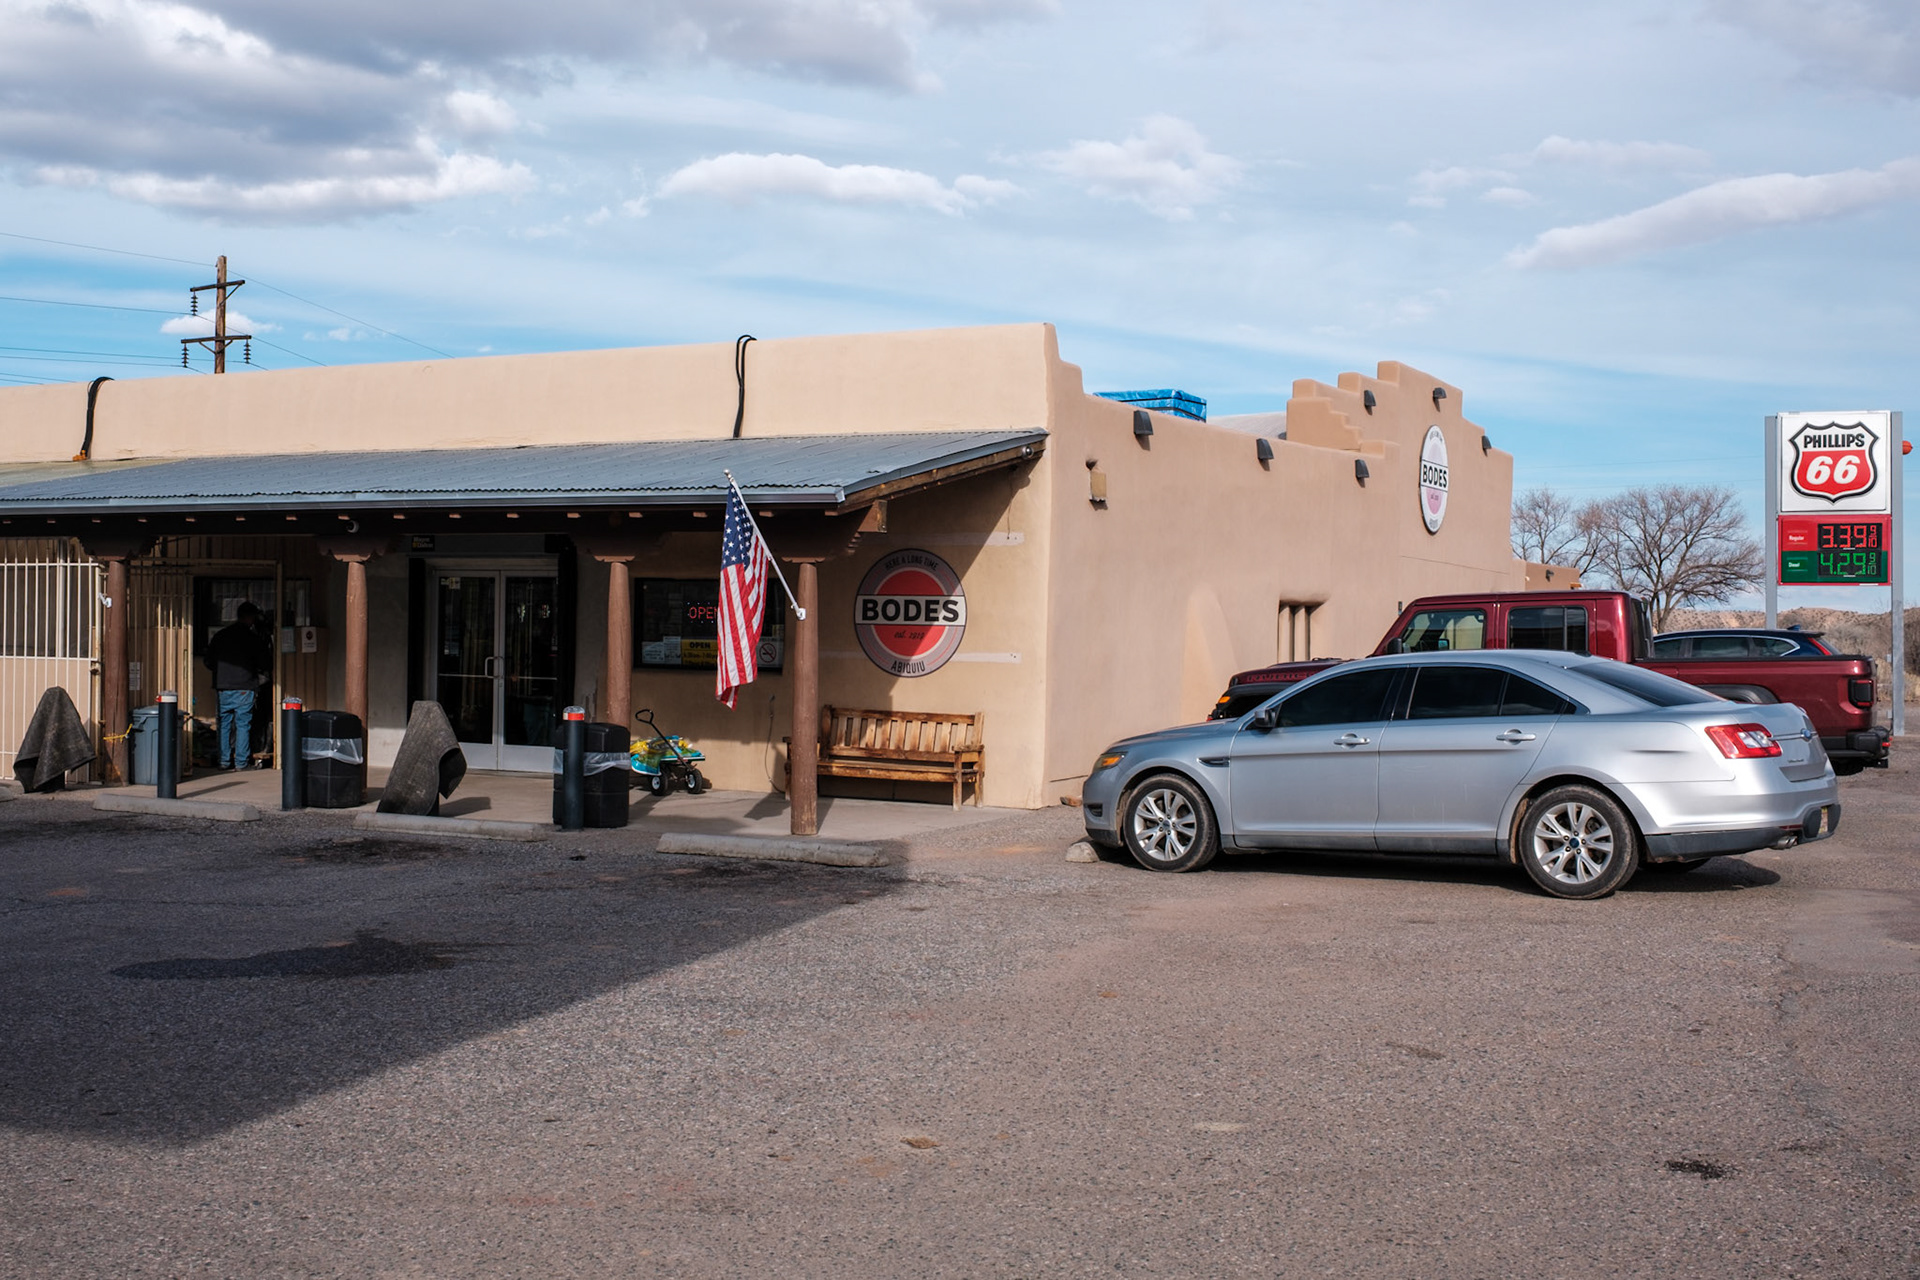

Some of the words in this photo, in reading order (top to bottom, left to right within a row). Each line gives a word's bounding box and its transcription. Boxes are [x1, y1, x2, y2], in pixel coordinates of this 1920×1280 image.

[1803, 433, 1865, 449] PHILLIPS
[1423, 464, 1447, 488] BODES
[1806, 454, 1861, 485] 66
[1822, 525, 1867, 548] 3.39
[901, 555, 906, 564] A
[907, 554, 923, 564] LONG
[924, 557, 939, 571] TIME
[1820, 552, 1866, 575] 4.29
[862, 598, 959, 623] BODES
[690, 641, 711, 649] OPEN
[890, 660, 926, 674] ABIQUIU
